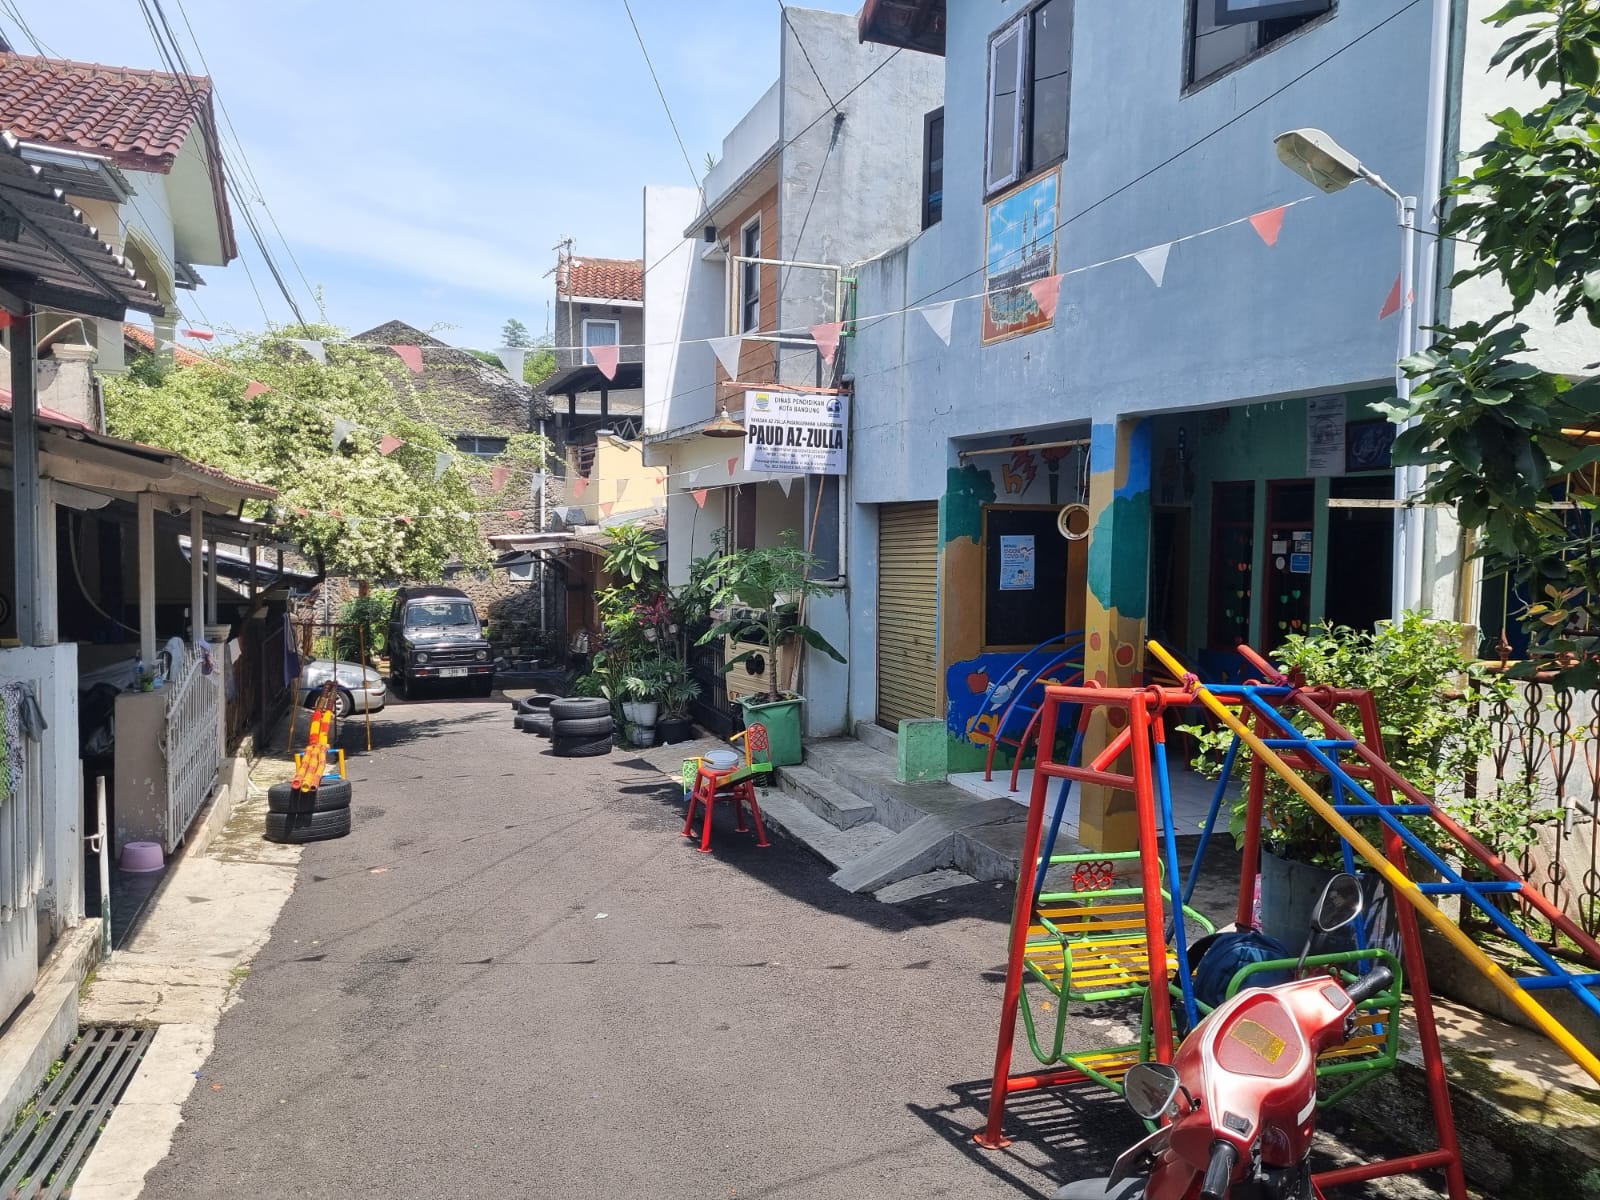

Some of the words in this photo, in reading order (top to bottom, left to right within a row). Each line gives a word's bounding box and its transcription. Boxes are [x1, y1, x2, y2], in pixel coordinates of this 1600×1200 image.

[792, 398, 825, 406] PENDIDIKAN
[793, 406, 820, 414] BANDUNG
[748, 424, 784, 446] PAUD
[786, 427, 843, 450] AZ-ZULLA
